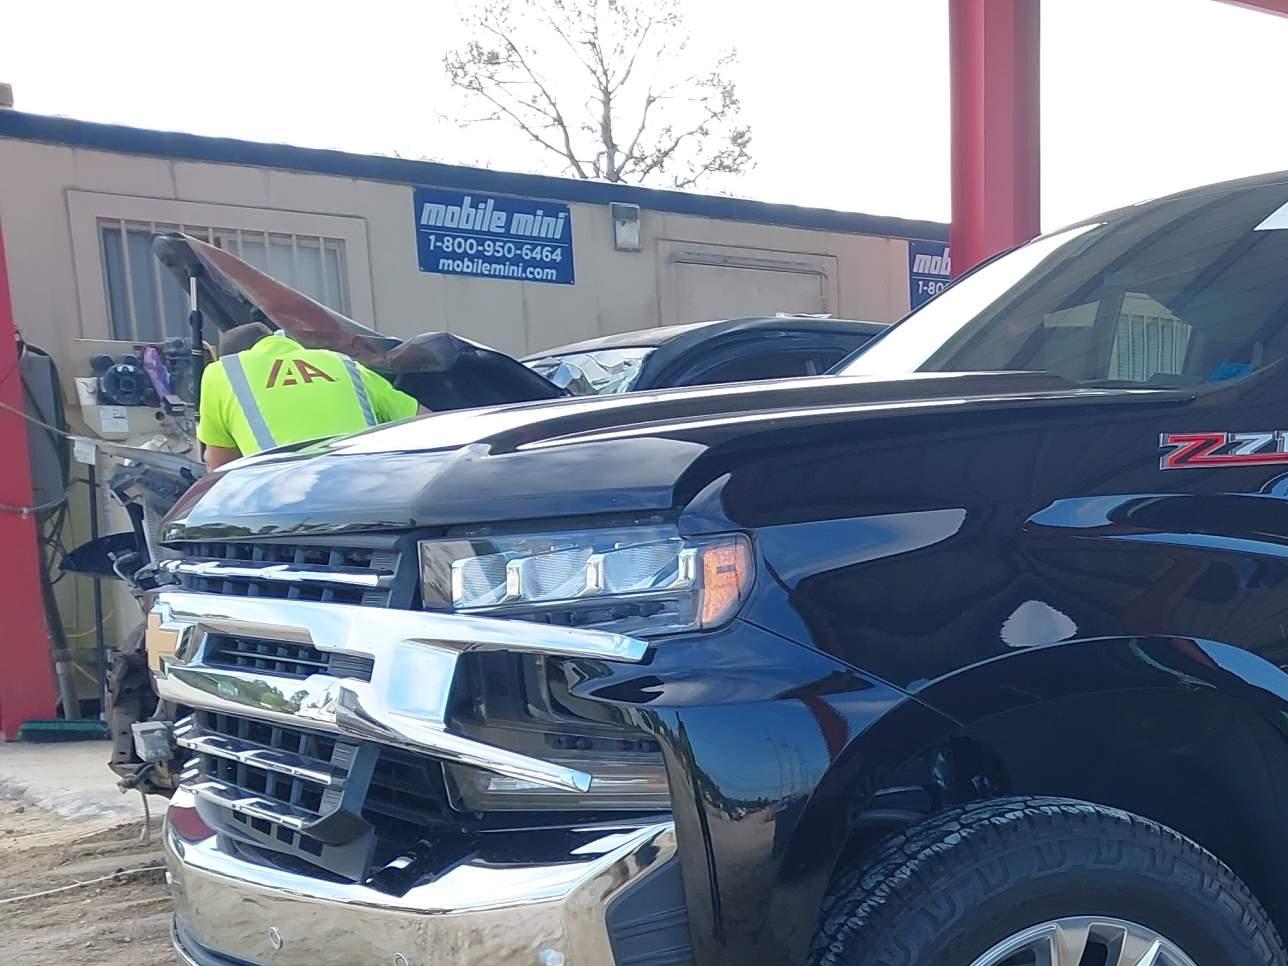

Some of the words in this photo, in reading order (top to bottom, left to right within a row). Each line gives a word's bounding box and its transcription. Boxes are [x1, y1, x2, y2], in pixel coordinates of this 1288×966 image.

[420, 196, 507, 233] mobile
[510, 209, 567, 239] mini
[428, 235, 562, 262] 1-800-950-6464
[438, 258, 557, 280] mobilemini.com
[918, 281, 946, 295] 1-80
